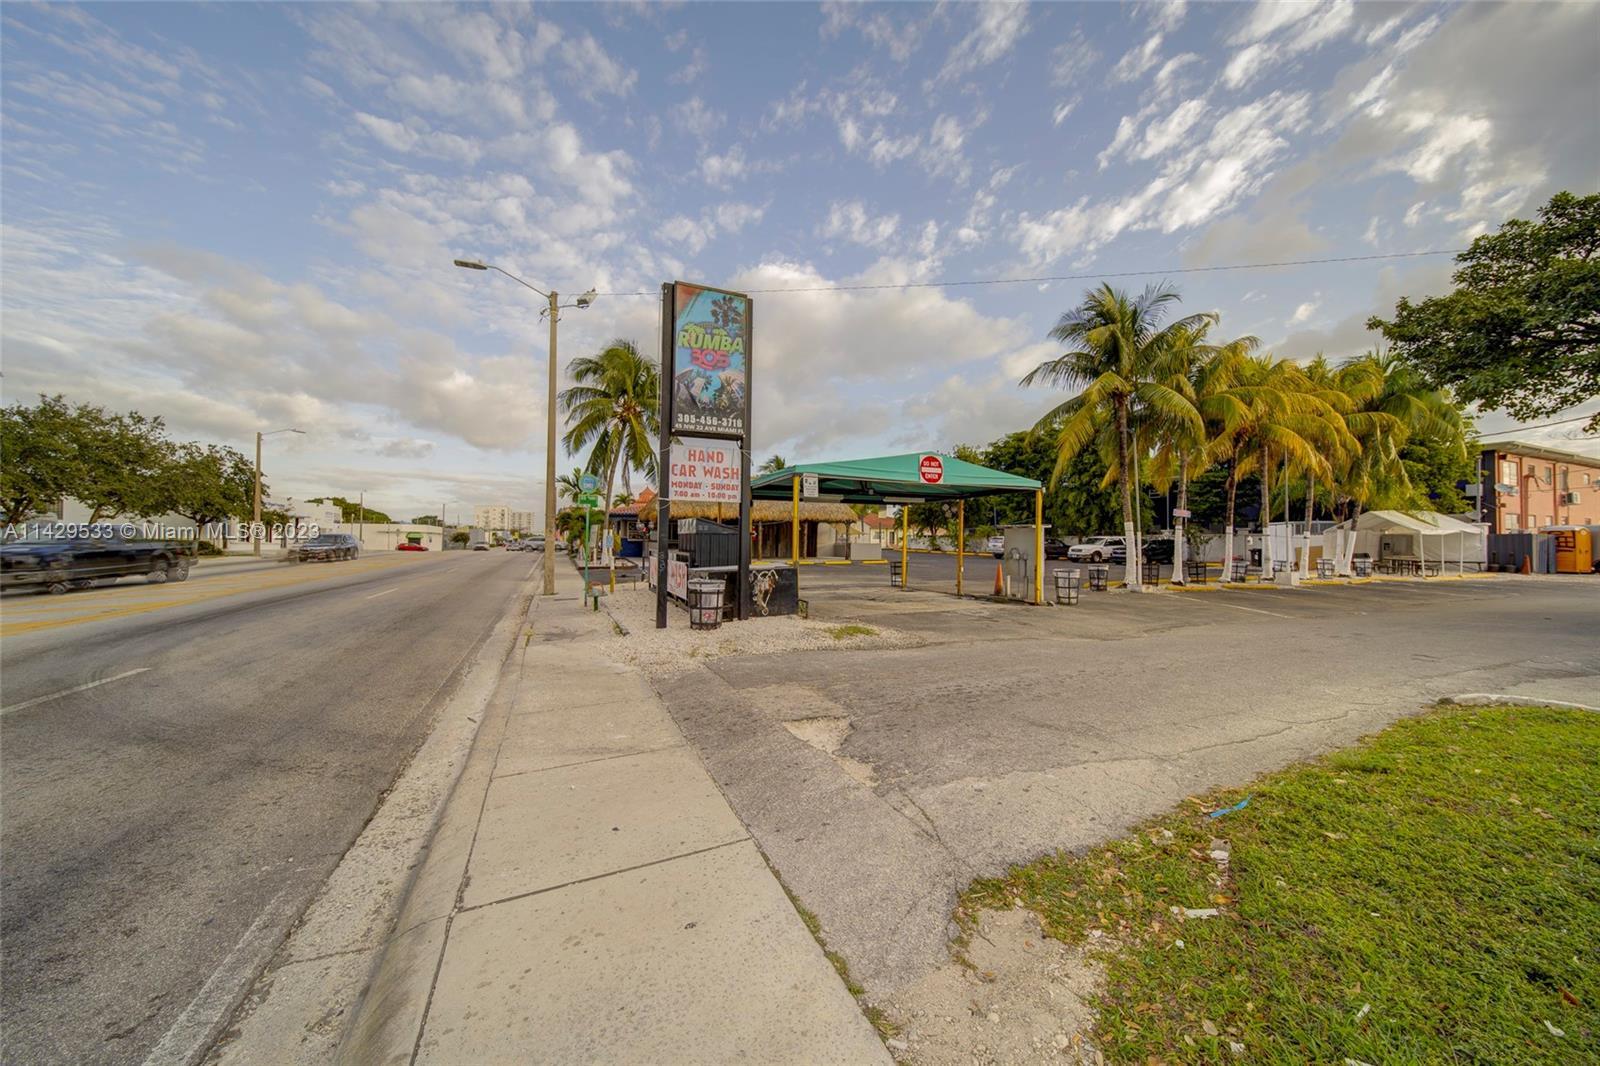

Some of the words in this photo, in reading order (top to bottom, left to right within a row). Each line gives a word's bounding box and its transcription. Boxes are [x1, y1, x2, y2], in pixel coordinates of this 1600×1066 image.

[678, 331, 744, 353] RUMBA
[691, 348, 731, 370] 305
[688, 449, 724, 463] HAND
[671, 463, 697, 477] CAR
[703, 465, 739, 480] WASH
[671, 481, 702, 489] MONDAY
[710, 482, 739, 491] SUNDAY
